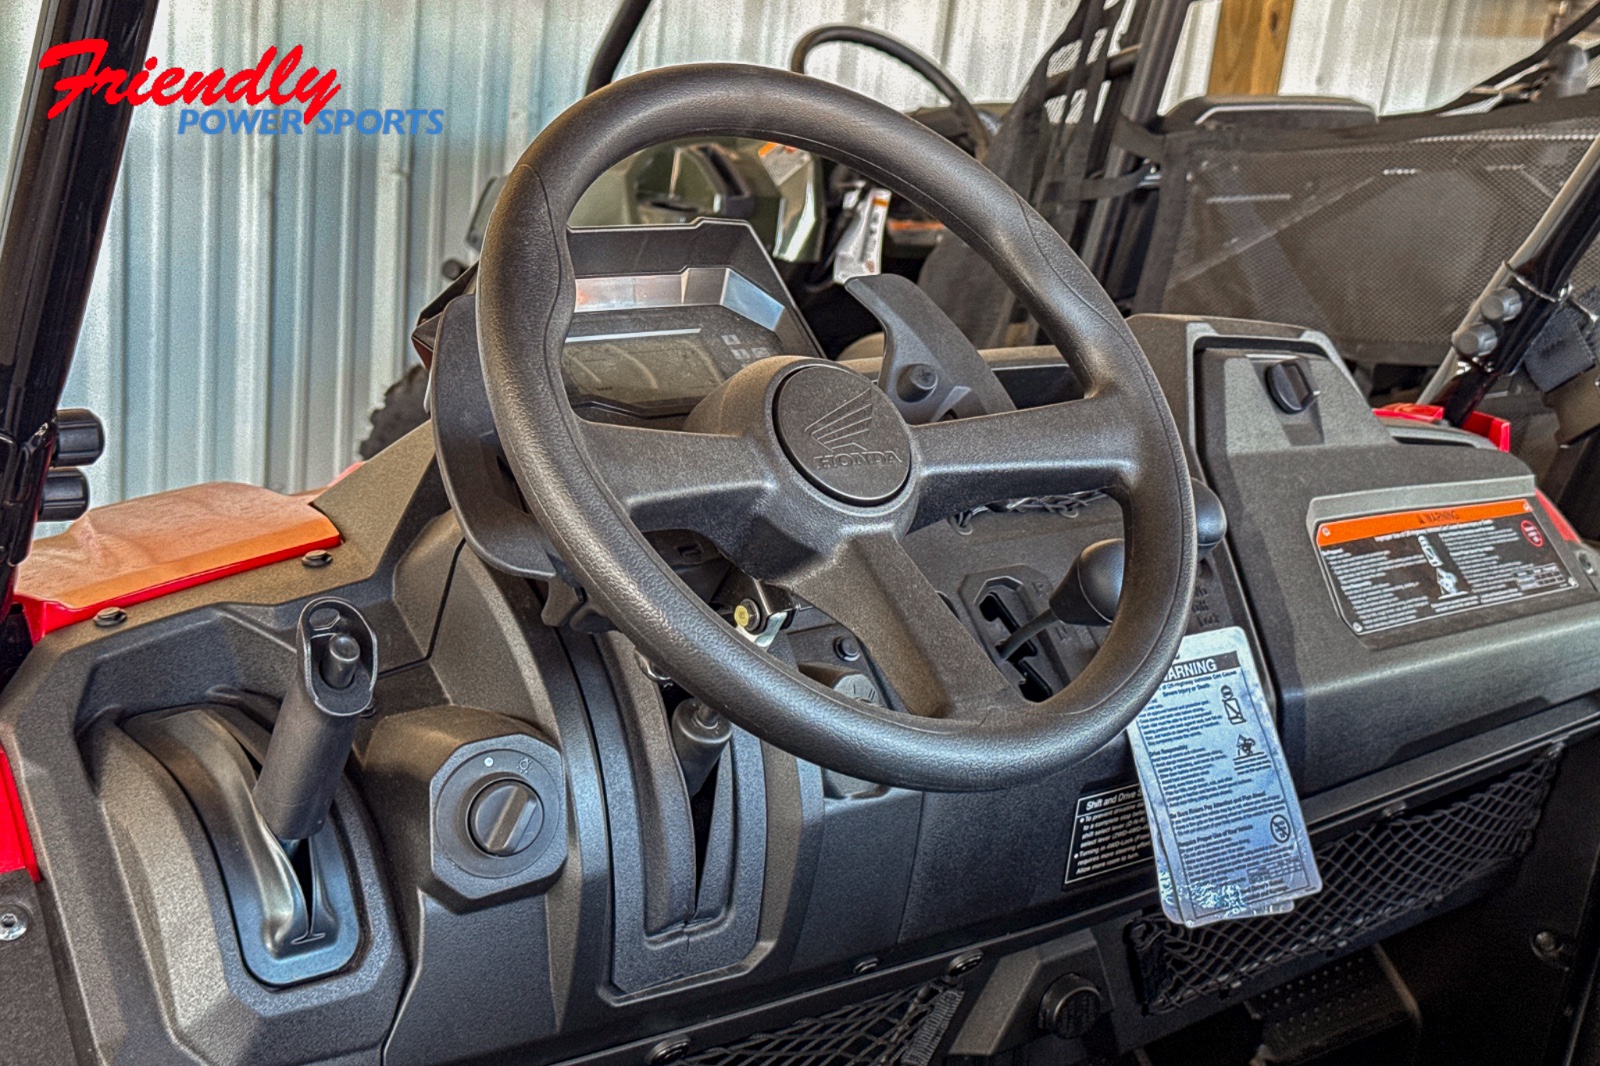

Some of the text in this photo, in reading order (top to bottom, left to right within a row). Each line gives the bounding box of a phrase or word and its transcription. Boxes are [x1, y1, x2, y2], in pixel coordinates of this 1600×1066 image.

[814, 451, 902, 468] HONDA
[1086, 799, 1103, 811] Shift
[1103, 795, 1117, 806] and
[1118, 791, 1137, 802] Drive
